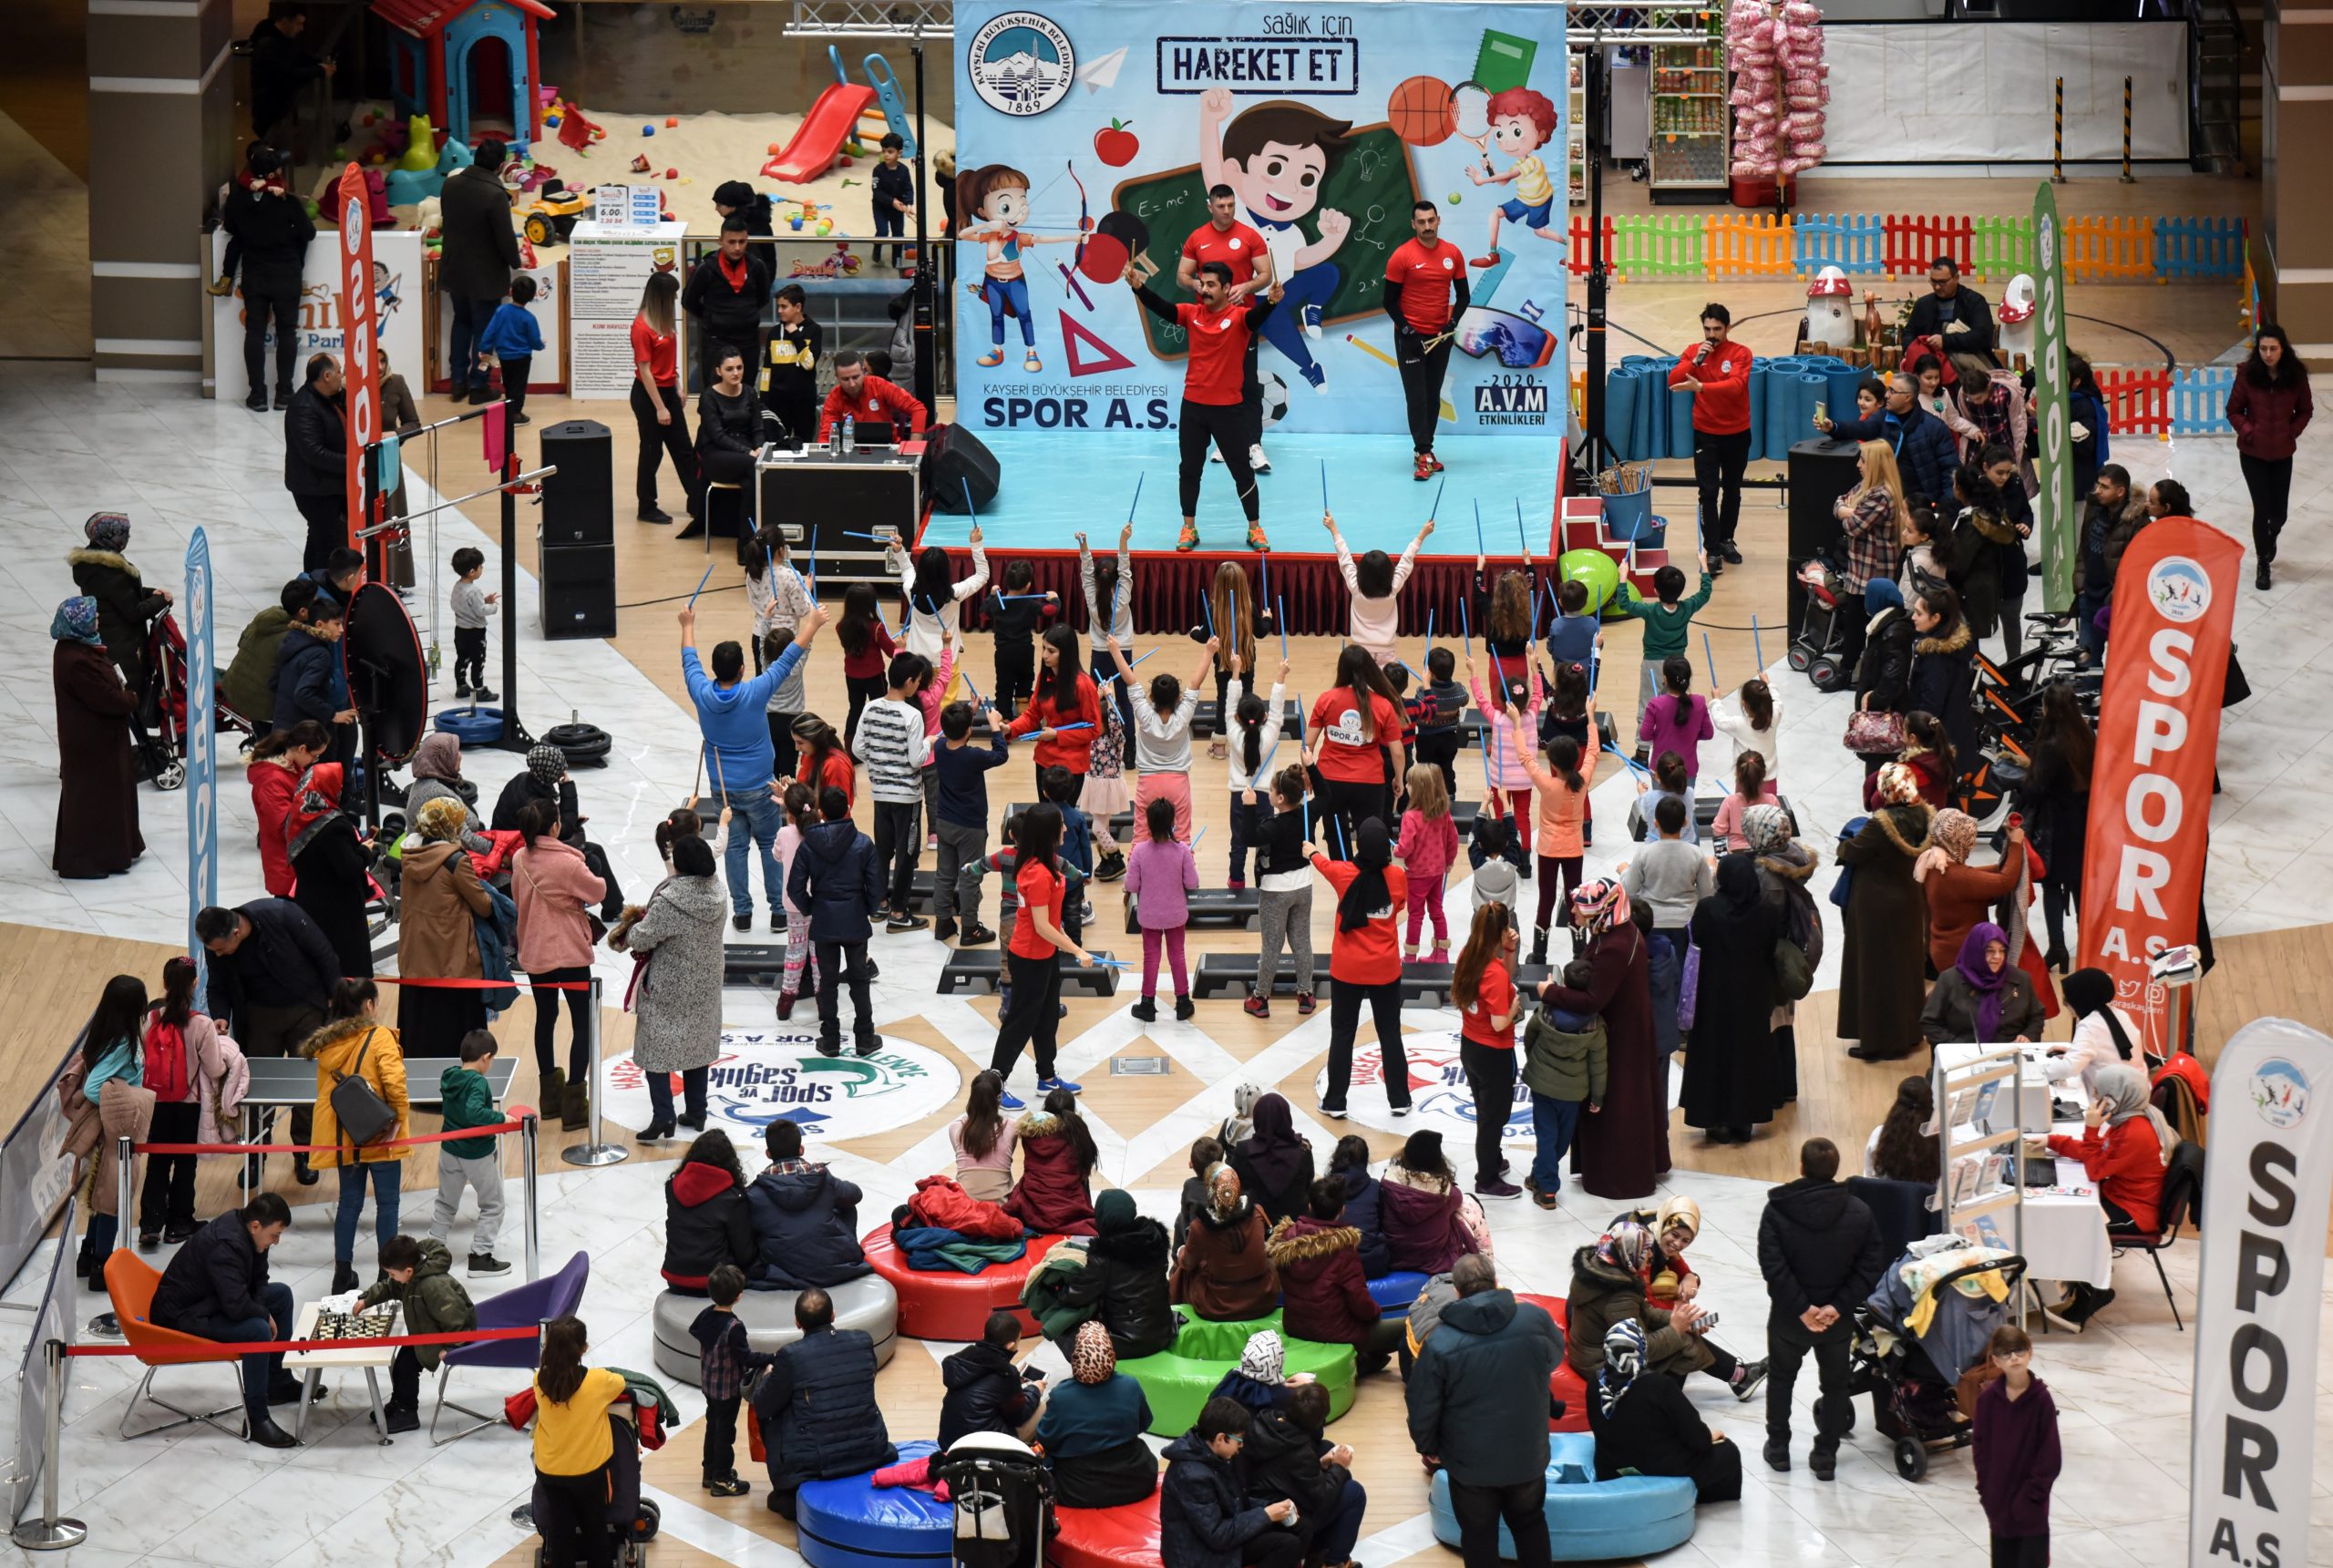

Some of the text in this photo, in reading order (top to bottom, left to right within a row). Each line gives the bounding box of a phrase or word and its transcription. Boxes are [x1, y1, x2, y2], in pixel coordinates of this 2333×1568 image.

[1263, 12, 1352, 38] sağlık için
[974, 16, 1073, 88] KAYSERİ BÜYÜKŞEHİR BELEDİYESİ
[1174, 47, 1343, 82] HAREKET ET
[1008, 100, 1041, 113] 1869
[308, 333, 344, 348] Par
[983, 384, 1168, 398] KAYSERİ BÜYÜKŞEHİR BELEDİYESİ
[1478, 387, 1545, 412] A.V.M
[983, 397, 1178, 432] SPOR A.Ş.
[1479, 413, 1546, 425] ETKİNLİKLERİ
[2115, 629, 2194, 921] SPOR
[739, 1081, 833, 1103] spor ve
[2223, 1140, 2297, 1513] SPOR
